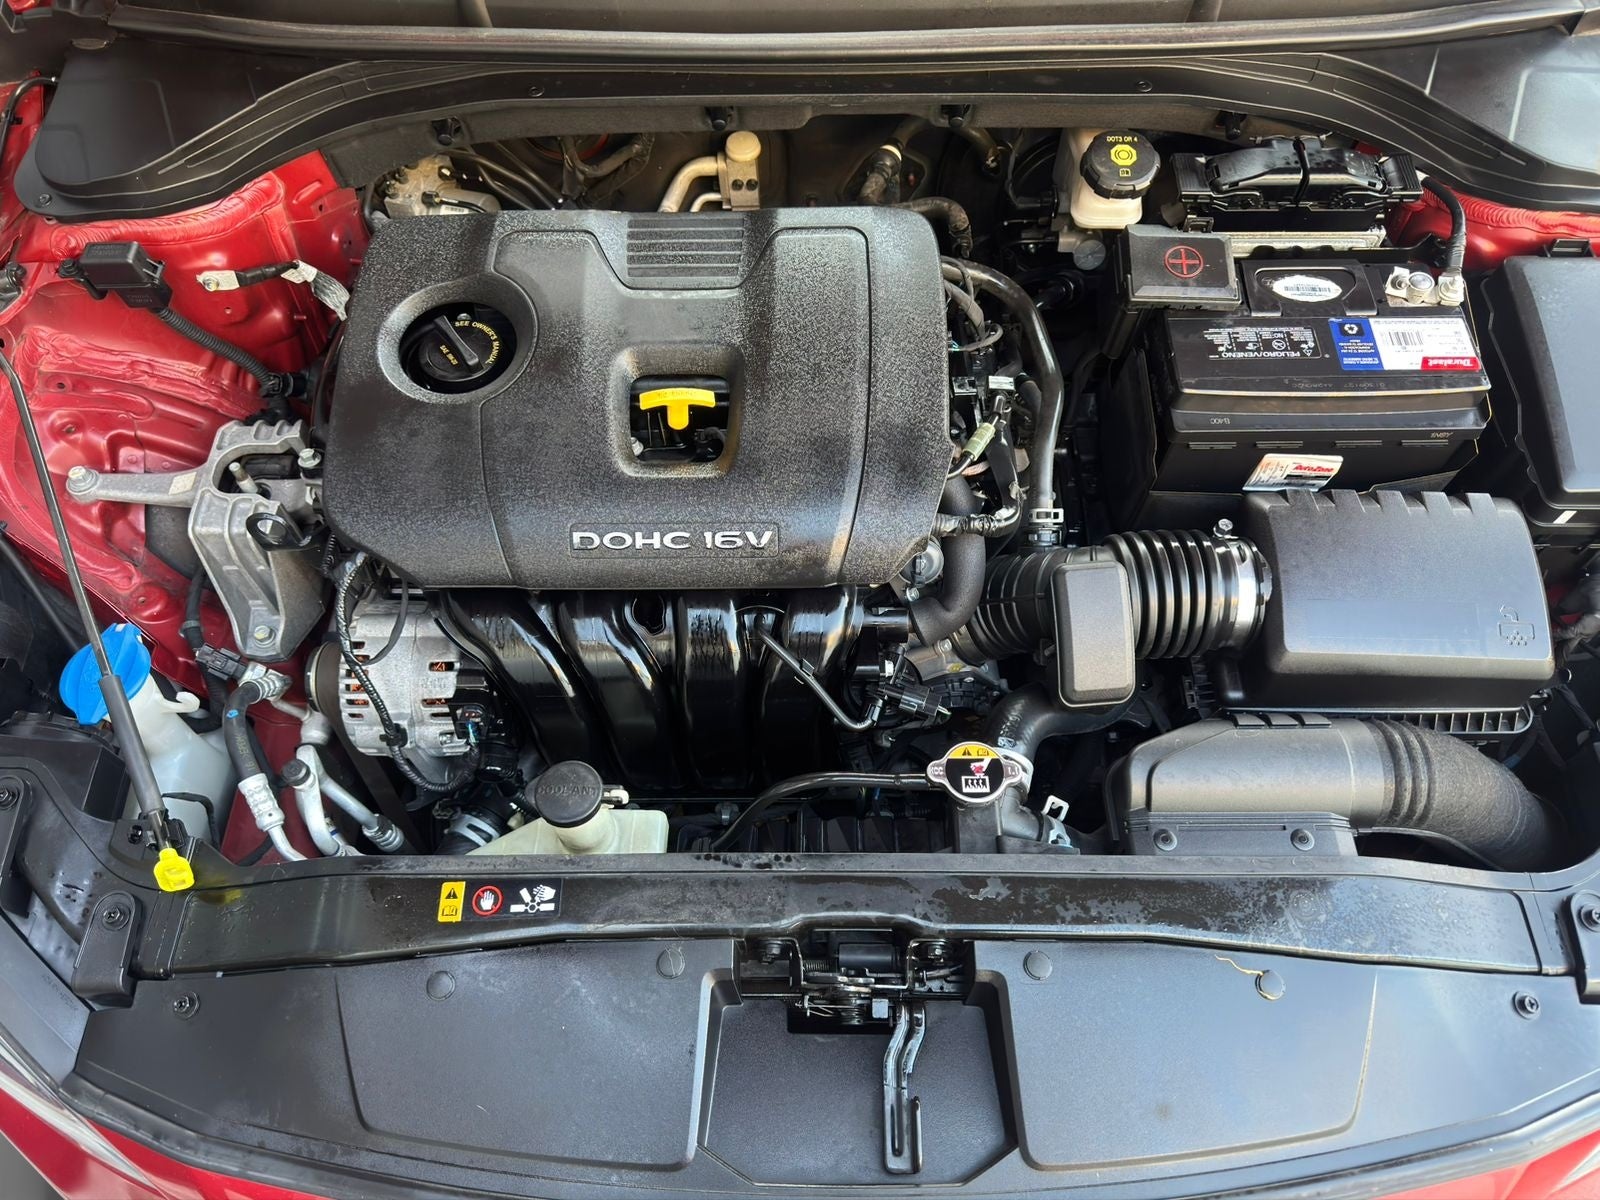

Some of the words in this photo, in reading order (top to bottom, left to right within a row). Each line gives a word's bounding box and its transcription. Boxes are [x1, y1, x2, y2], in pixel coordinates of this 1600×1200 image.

[471, 321, 498, 341] OWNER'S
[485, 341, 500, 364] MANUAL
[1427, 358, 1475, 367] Duralast
[1292, 464, 1335, 473] AutoZone
[572, 531, 691, 550] DOHC
[703, 531, 773, 549] 16V
[538, 783, 599, 798] COOLANT
